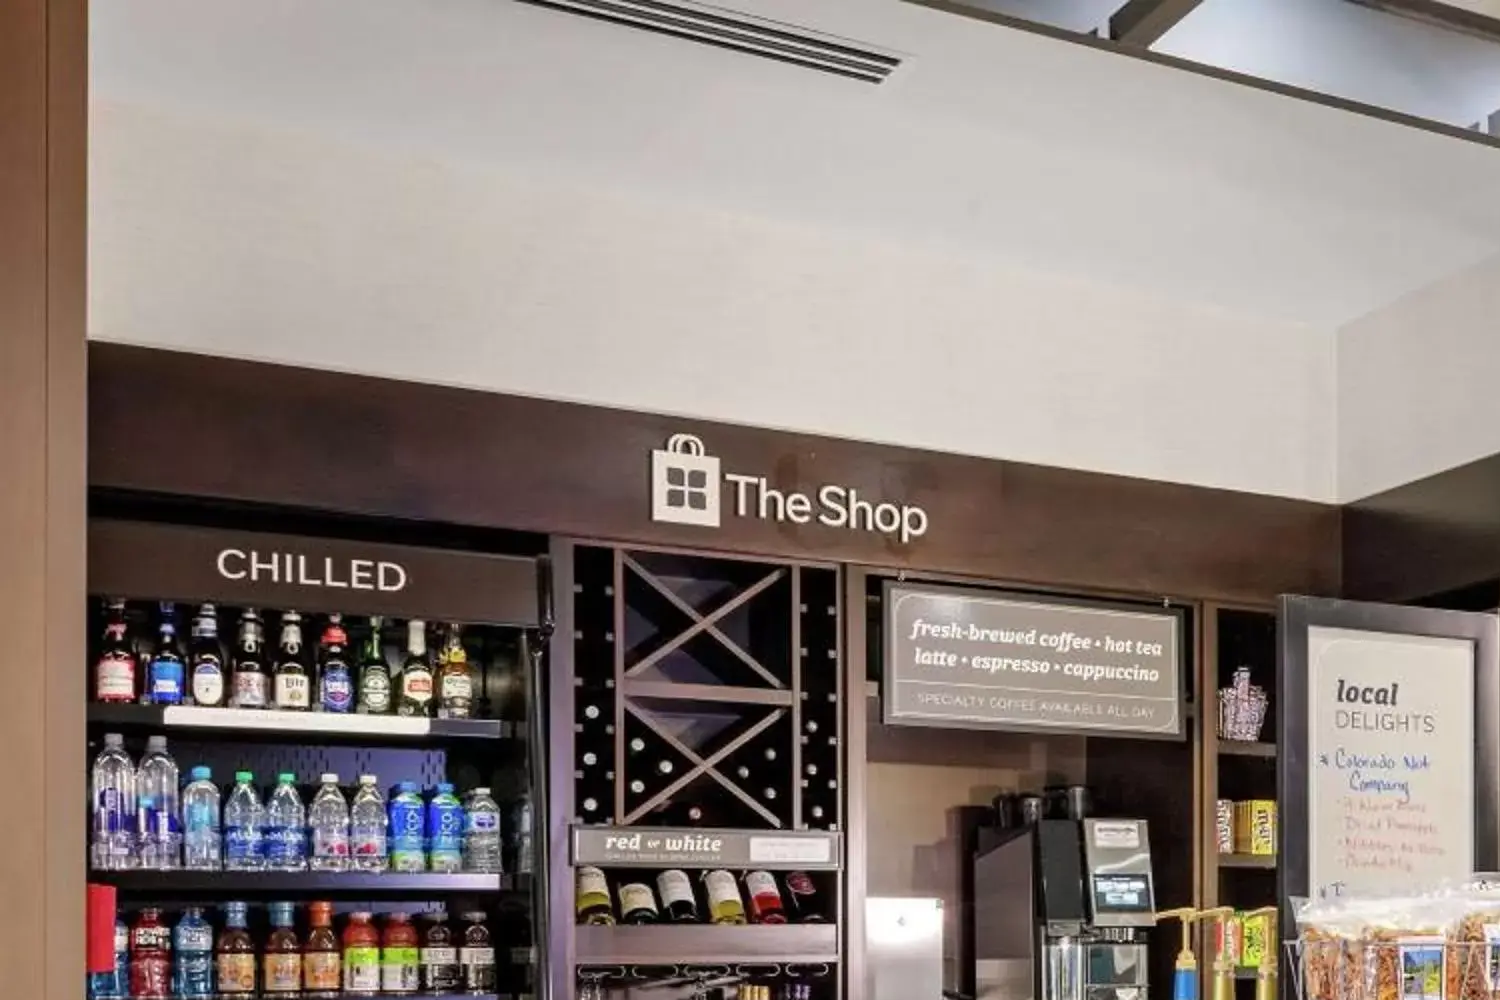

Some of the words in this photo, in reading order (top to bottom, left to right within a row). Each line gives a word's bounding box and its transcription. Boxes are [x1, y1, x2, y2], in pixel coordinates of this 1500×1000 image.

[725, 473, 812, 524] The
[818, 485, 928, 544] Shop
[217, 548, 407, 591] CHILLED
[908, 618, 1037, 645] fresh-brewed
[1039, 631, 1093, 653] coffee
[1104, 635, 1133, 653] hot
[1136, 641, 1163, 656] tea
[915, 646, 958, 667] latte
[971, 655, 1051, 675] espresso
[1063, 663, 1160, 682] cappuccino
[918, 693, 986, 708] SPECIALTY
[989, 697, 1036, 711] COFFEE
[1040, 702, 1103, 715] AVAILABLE
[1107, 704, 1128, 718] ALL
[1132, 706, 1156, 719] DAY
[1337, 679, 1400, 706] local
[1335, 709, 1436, 733] DELIGHTS
[1335, 748, 1396, 770] Colorado
[1350, 770, 1411, 805] Company
[605, 833, 642, 851] red
[665, 834, 722, 852] white
